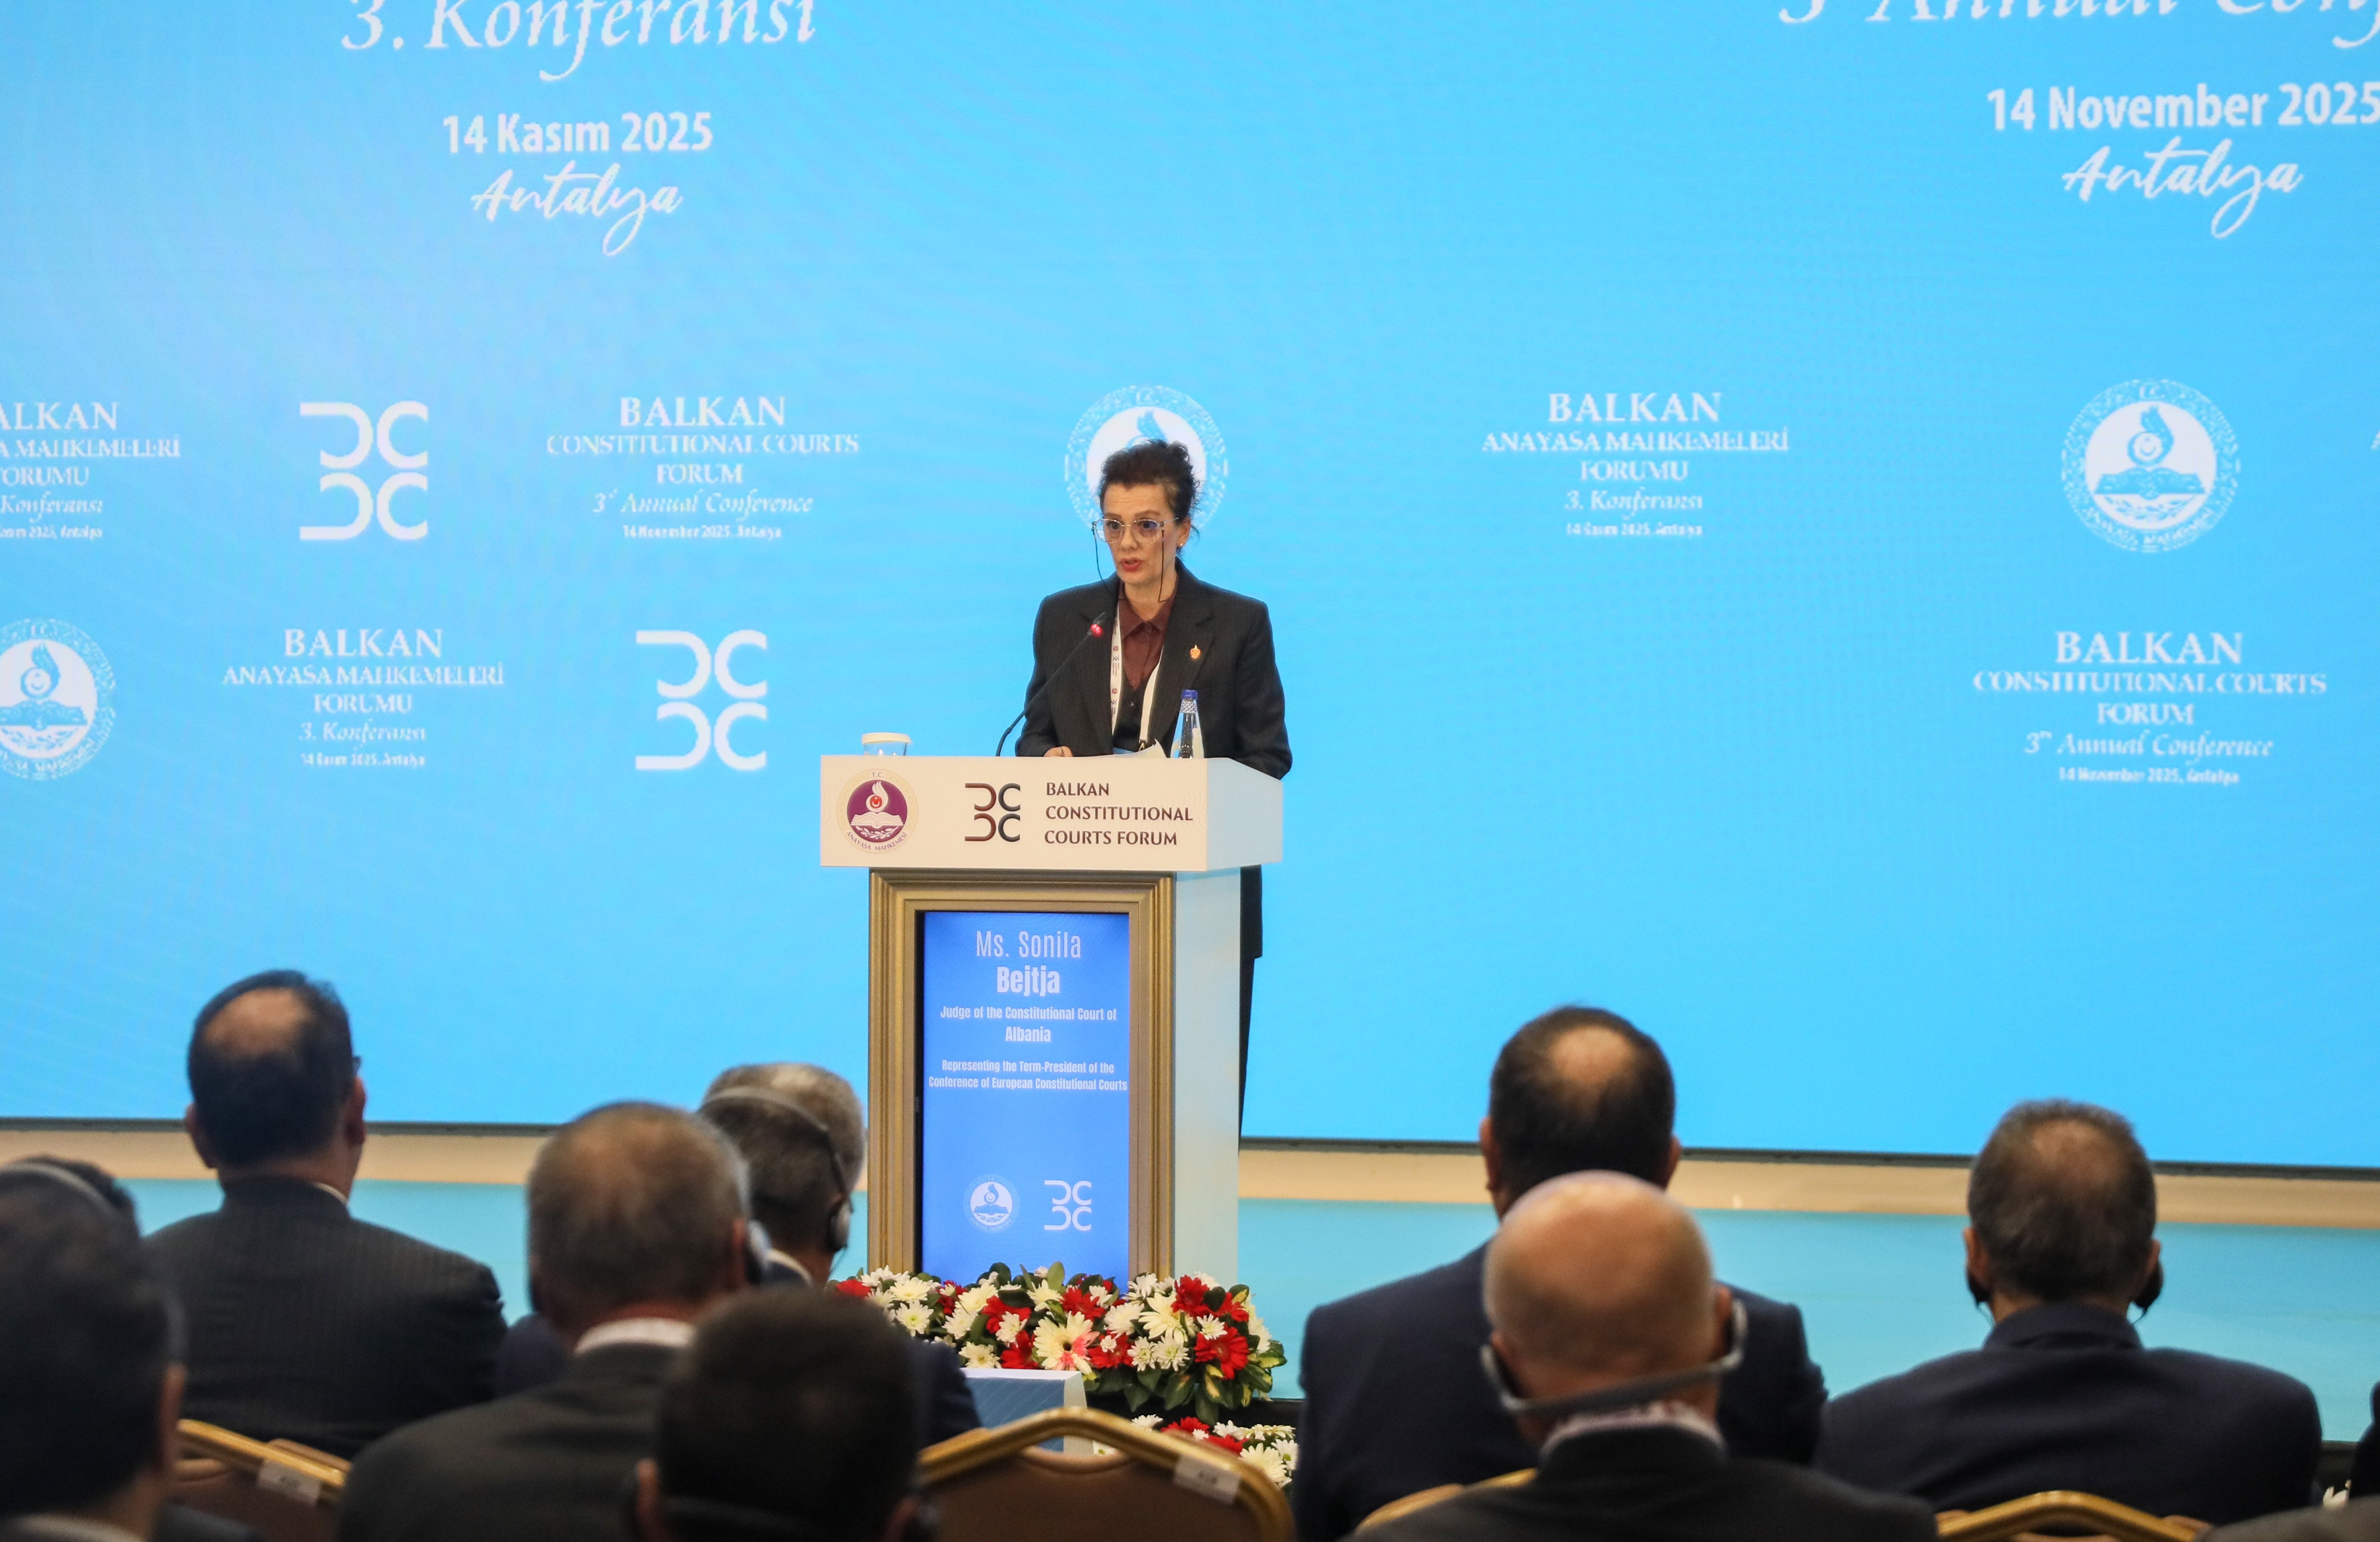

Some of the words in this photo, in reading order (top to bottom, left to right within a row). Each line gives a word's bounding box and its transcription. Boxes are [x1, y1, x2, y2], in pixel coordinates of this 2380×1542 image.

[342, 0, 404, 50] 3.
[1987, 88, 2037, 131] 14
[2049, 83, 2268, 130] November
[2279, 81, 2380, 127] 2025
[443, 116, 487, 154] 14
[498, 113, 610, 153] Kasım
[622, 112, 713, 152] 2025
[2062, 136, 2304, 240] Antalya
[471, 160, 684, 257] Antalya
[0, 403, 119, 431] LKAN
[620, 396, 785, 427] BALKAN
[1549, 392, 1722, 422] BALKAN
[546, 434, 756, 455] CONSTITUTIONAL
[762, 434, 860, 454] COURTS
[1482, 430, 1601, 452] ANAYASA
[2, 467, 90, 487] ORUMU
[657, 464, 744, 485] FORUM
[705, 488, 813, 522] Conference
[285, 628, 443, 658] BALKAN
[2055, 632, 2243, 665] BALKAN
[223, 665, 332, 686] ANAYASA
[2217, 673, 2327, 694] COURTS
[2097, 703, 2195, 725] FORUM
[1046, 782, 1109, 796] BALKAN
[1046, 806, 1193, 821] CONSTITUTIONAL
[846, 831, 871, 850] ANAYASA
[874, 832, 908, 851] MAHKEMESİ
[1044, 830, 1111, 845] COURTS
[1117, 831, 1177, 845] FORUM
[976, 930, 1010, 958] Ms.
[1019, 931, 1082, 958] Sonila
[997, 965, 1061, 997] Bejtja
[940, 1006, 971, 1020] Judge
[974, 1007, 984, 1019] of
[987, 1007, 1002, 1019] the
[1005, 1006, 1075, 1021] Constitutional
[1077, 1008, 1104, 1021] Court
[1107, 1009, 1117, 1021] of
[1005, 1026, 1052, 1043] Albania
[942, 1060, 1001, 1073] Representing
[1002, 1061, 1017, 1072] the
[1019, 1061, 1087, 1074] Term-President
[1089, 1062, 1098, 1074] of
[1100, 1063, 1115, 1074] the
[928, 1077, 979, 1088] Conference
[981, 1078, 990, 1088] of
[992, 1078, 1033, 1091] European
[1035, 1078, 1097, 1091] Constitutional
[1099, 1080, 1128, 1091] Courts
